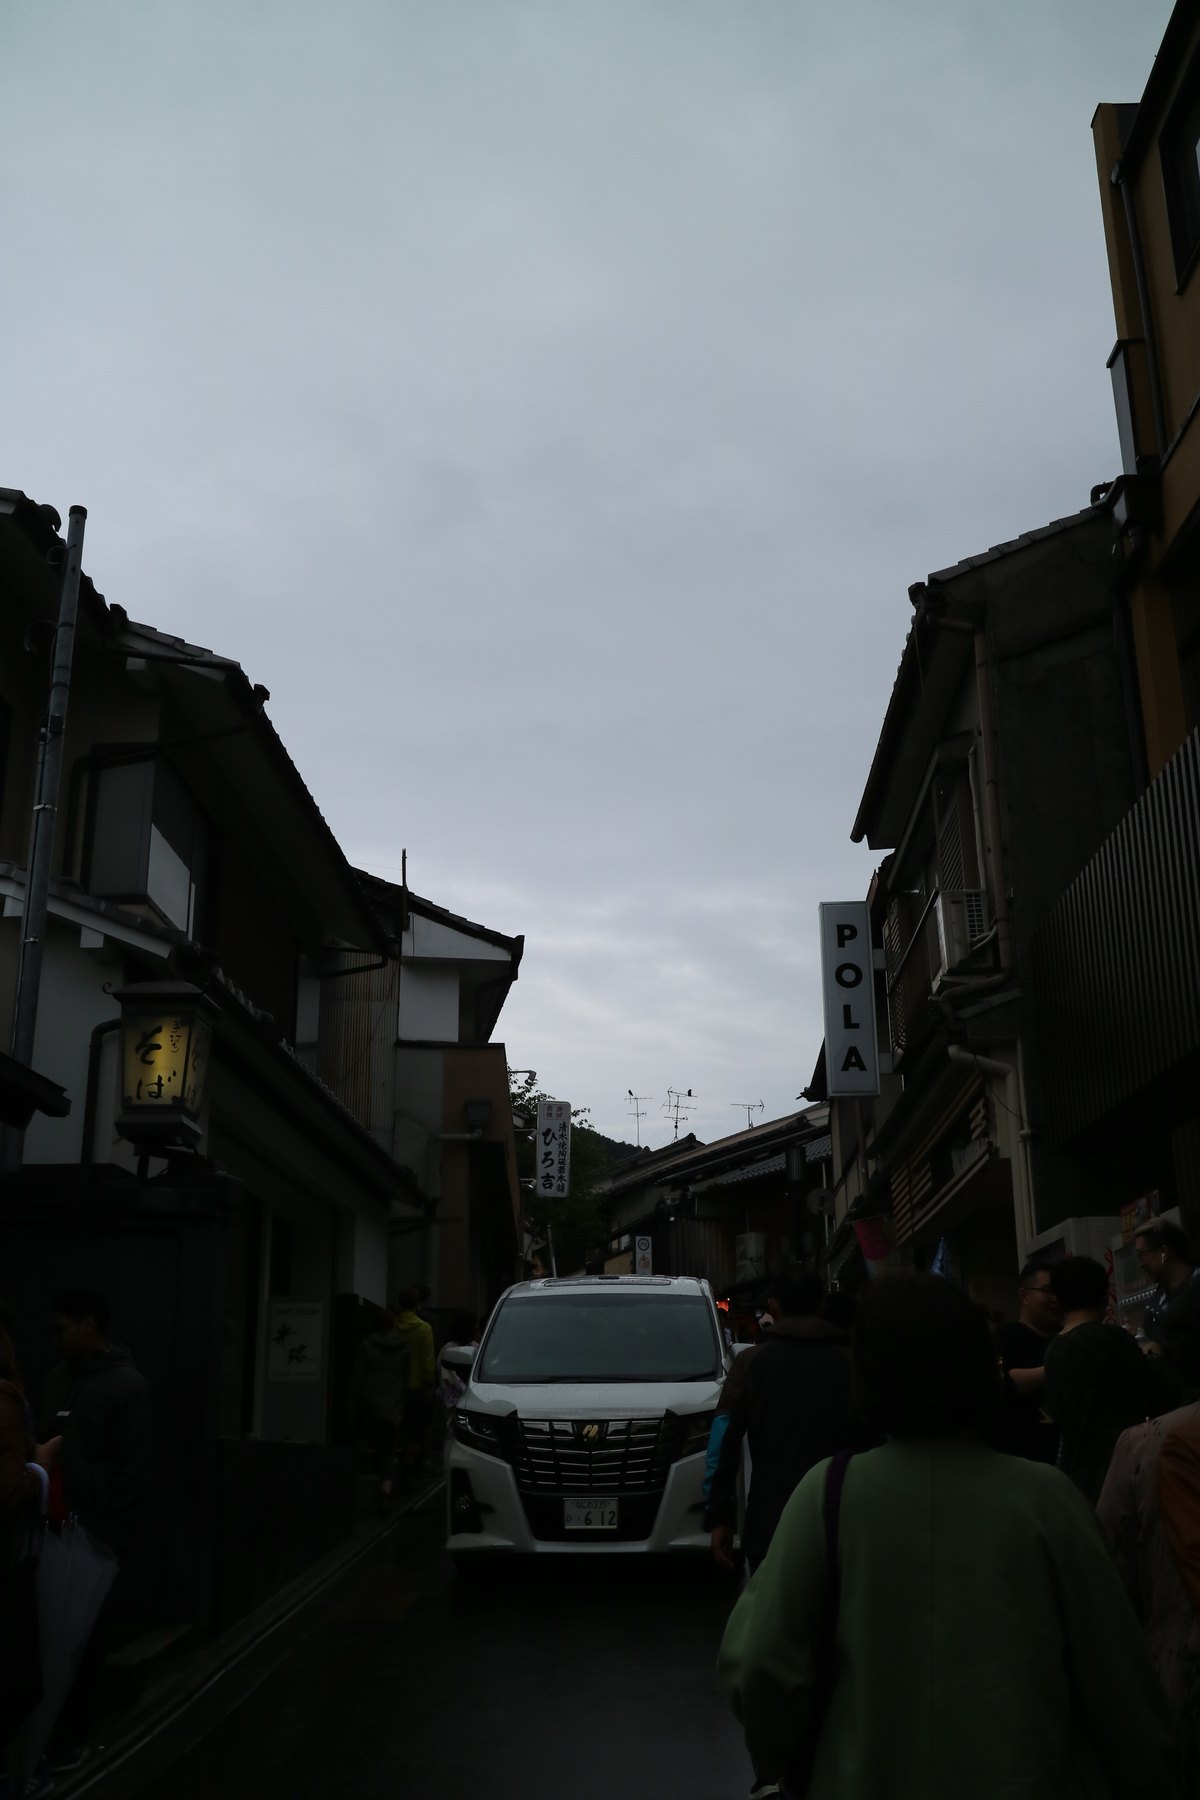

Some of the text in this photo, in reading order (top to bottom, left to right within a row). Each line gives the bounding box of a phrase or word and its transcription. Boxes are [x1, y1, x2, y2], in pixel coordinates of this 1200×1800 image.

[835, 924, 867, 1072] POLA
[135, 1025, 177, 1100] そば
[541, 1128, 558, 1190] ひろ吉
